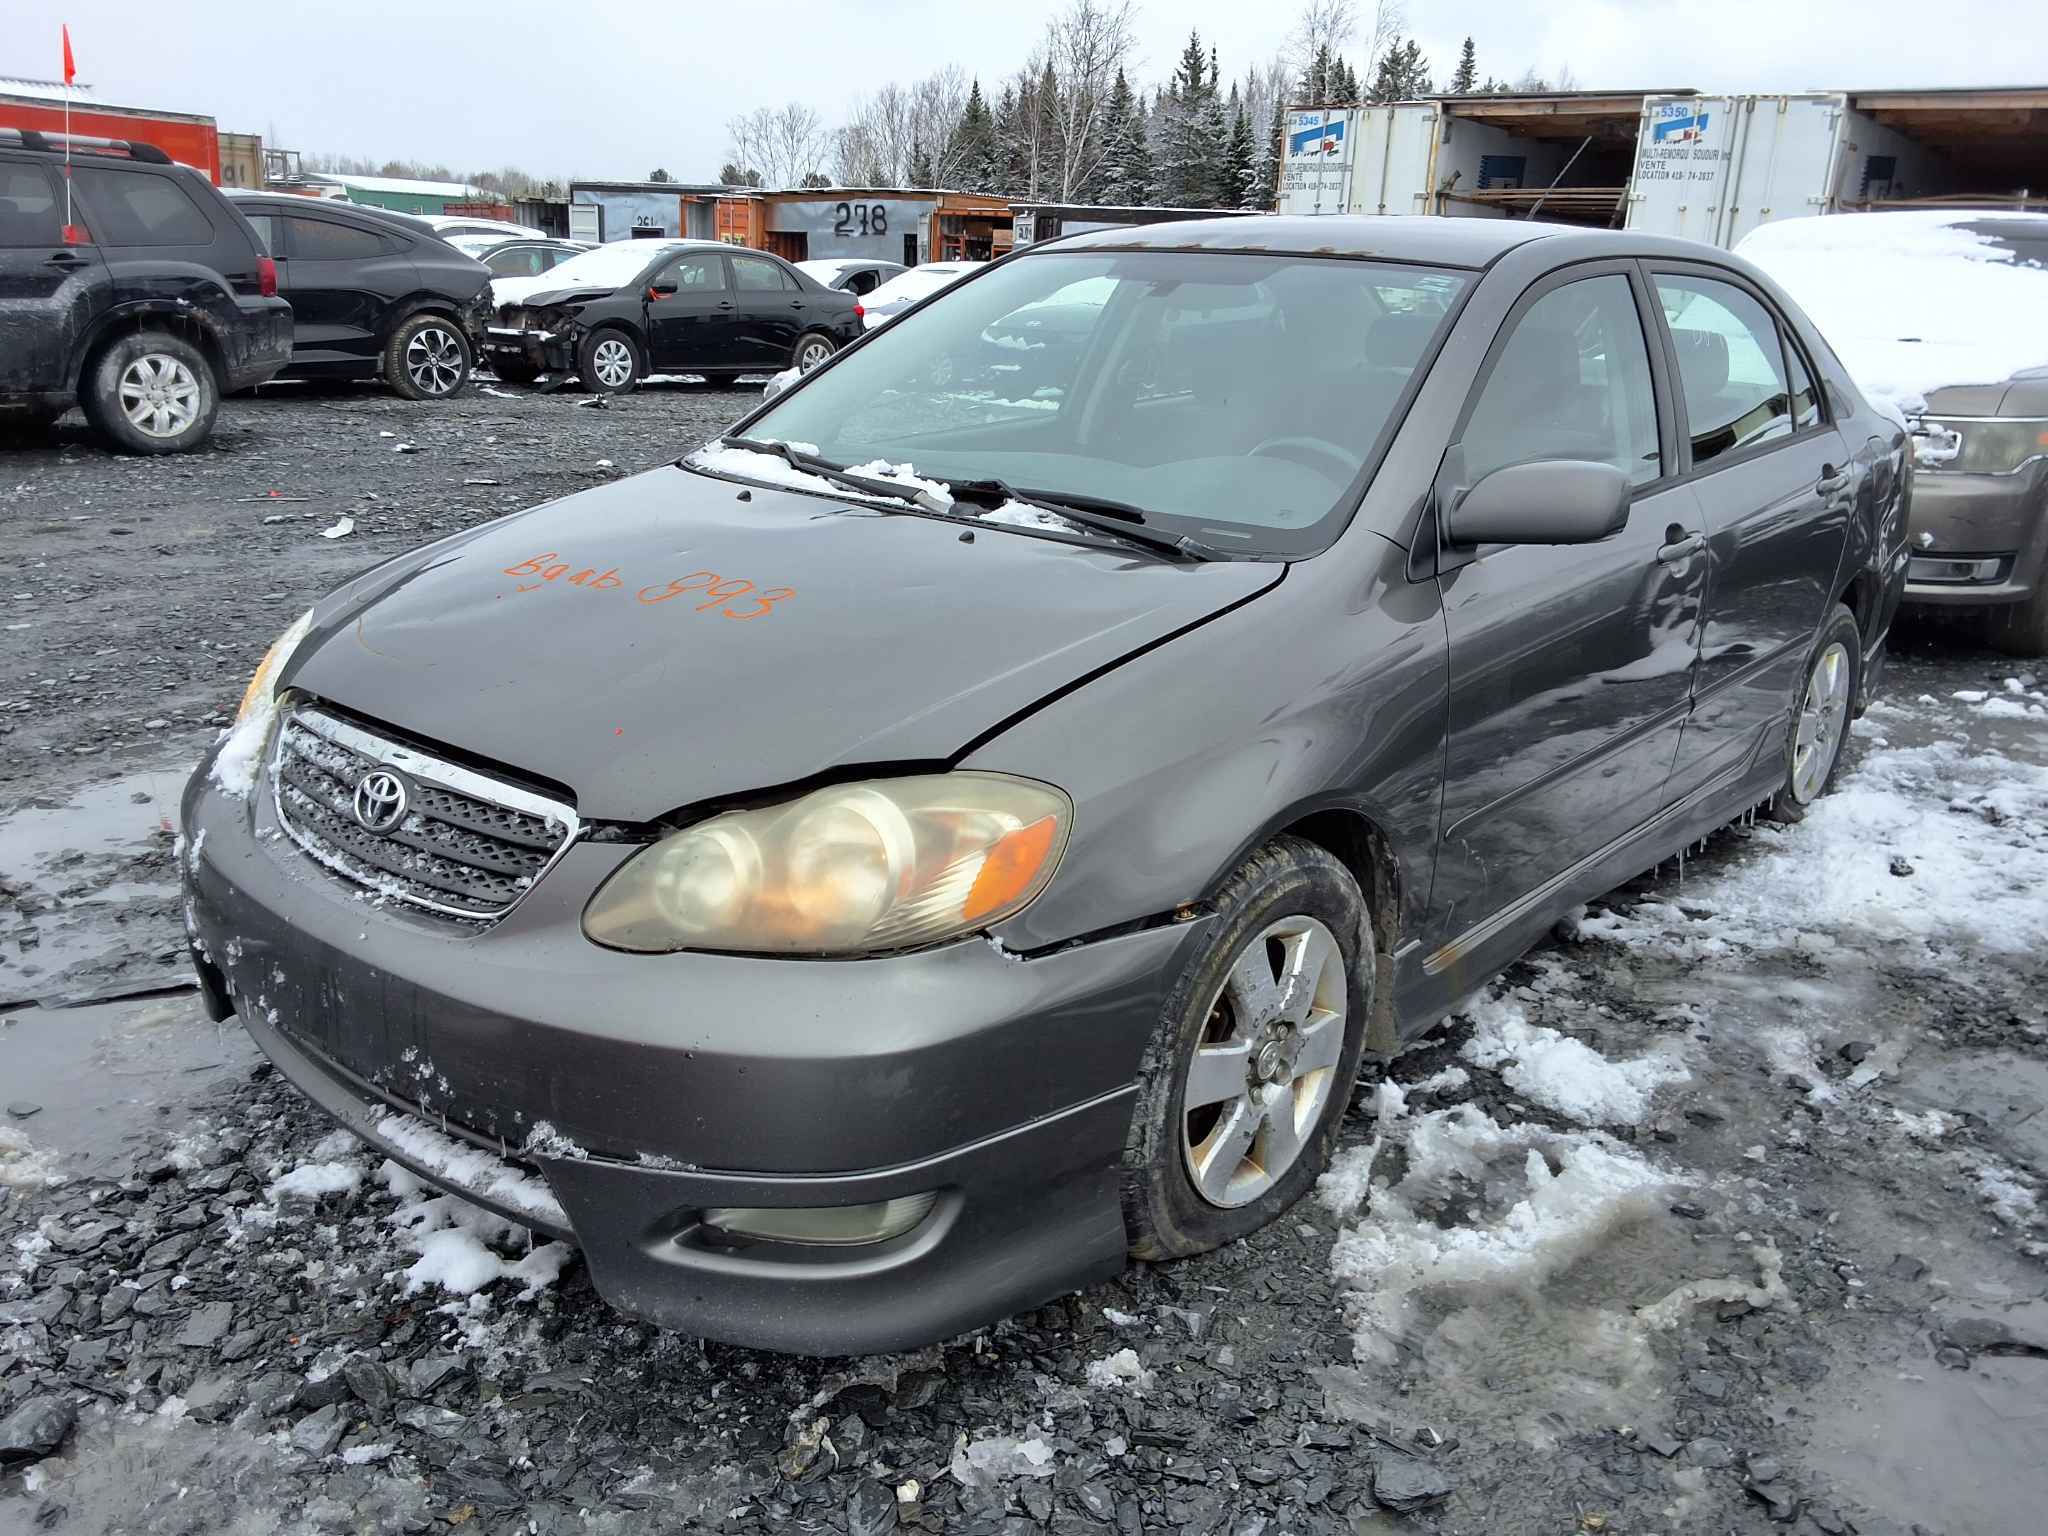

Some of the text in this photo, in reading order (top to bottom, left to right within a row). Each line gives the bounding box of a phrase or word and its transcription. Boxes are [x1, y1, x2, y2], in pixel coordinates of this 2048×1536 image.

[1661, 107, 1688, 117] 5350
[1298, 116, 1319, 126] 5345
[1640, 161, 1667, 170] VENTE
[1283, 173, 1304, 181] VENTE
[1638, 170, 1669, 180] LOCATION
[1282, 183, 1307, 191] LOCATION
[834, 202, 888, 237] 278
